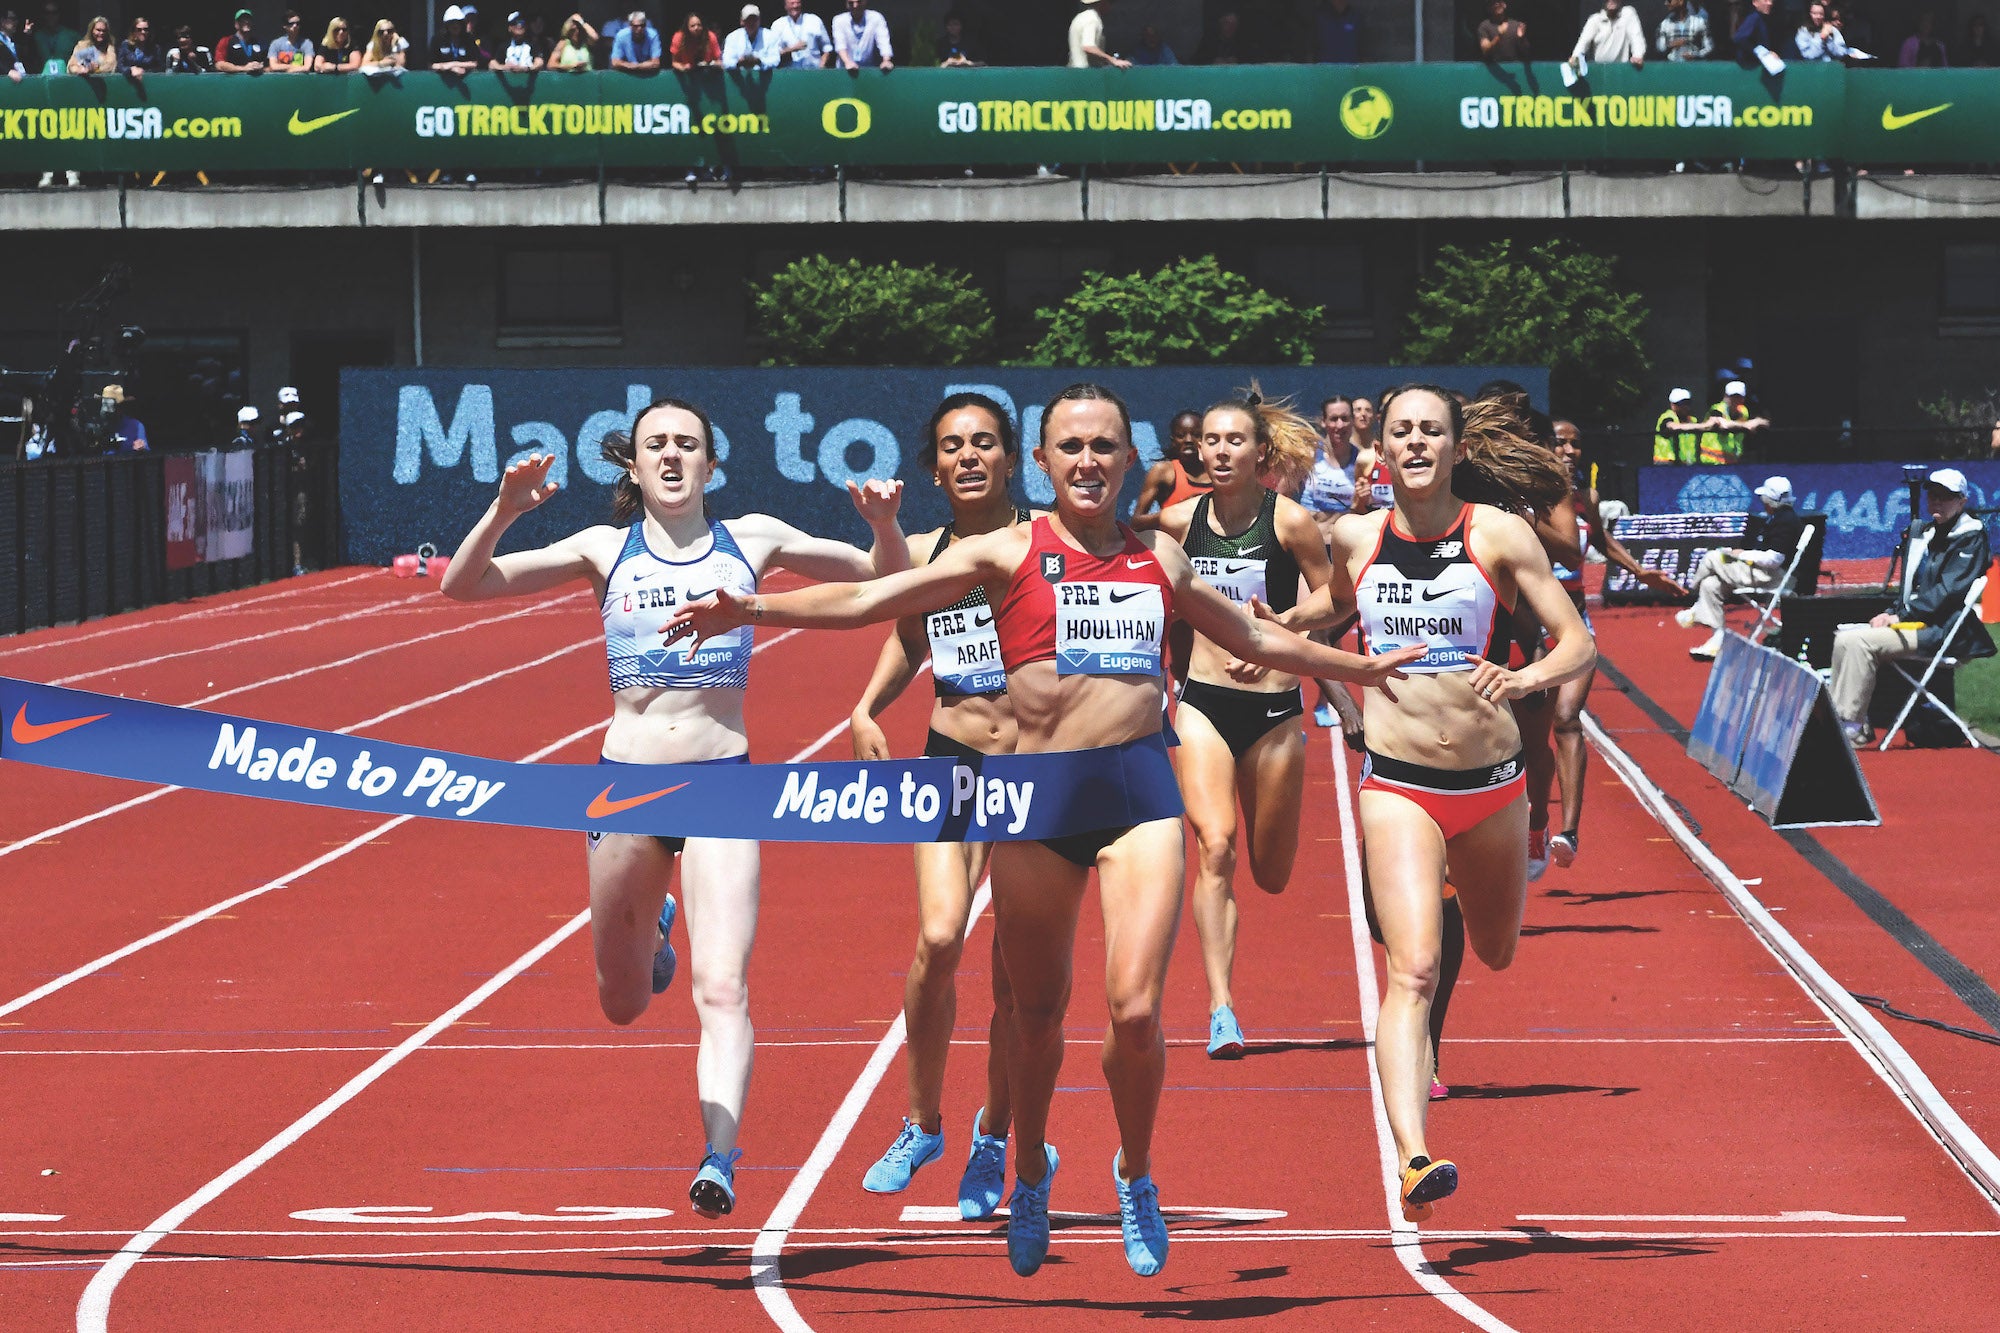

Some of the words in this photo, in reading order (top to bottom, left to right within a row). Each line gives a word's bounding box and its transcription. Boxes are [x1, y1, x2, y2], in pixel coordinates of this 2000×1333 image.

[0, 107, 242, 140] KTOWNUSA.com
[415, 104, 770, 137] GOTRACKTOWNUSA.com
[938, 99, 1292, 133] GOTRACKTOWNUSA.com
[1460, 95, 1813, 129] GOTRACKTOWNUSA.com
[393, 384, 730, 494] Mad
[765, 392, 901, 490] to
[1195, 559, 1218, 575] PRE
[637, 586, 676, 609] PRE
[1061, 584, 1100, 606] PRE
[1211, 585, 1244, 601] ALL
[1376, 582, 1413, 604] PRE
[932, 612, 967, 638] PRE
[1066, 619, 1156, 643] HOULIHAN
[1383, 616, 1463, 637] SIMPSON
[957, 640, 998, 665] ARAF
[1099, 654, 1153, 671] Eugene
[1414, 650, 1467, 665] ugene
[208, 723, 337, 790] Made
[346, 750, 397, 797] to
[403, 756, 506, 817] Play
[772, 769, 888, 824] Made
[899, 768, 941, 823] to
[951, 764, 1035, 835] Play
